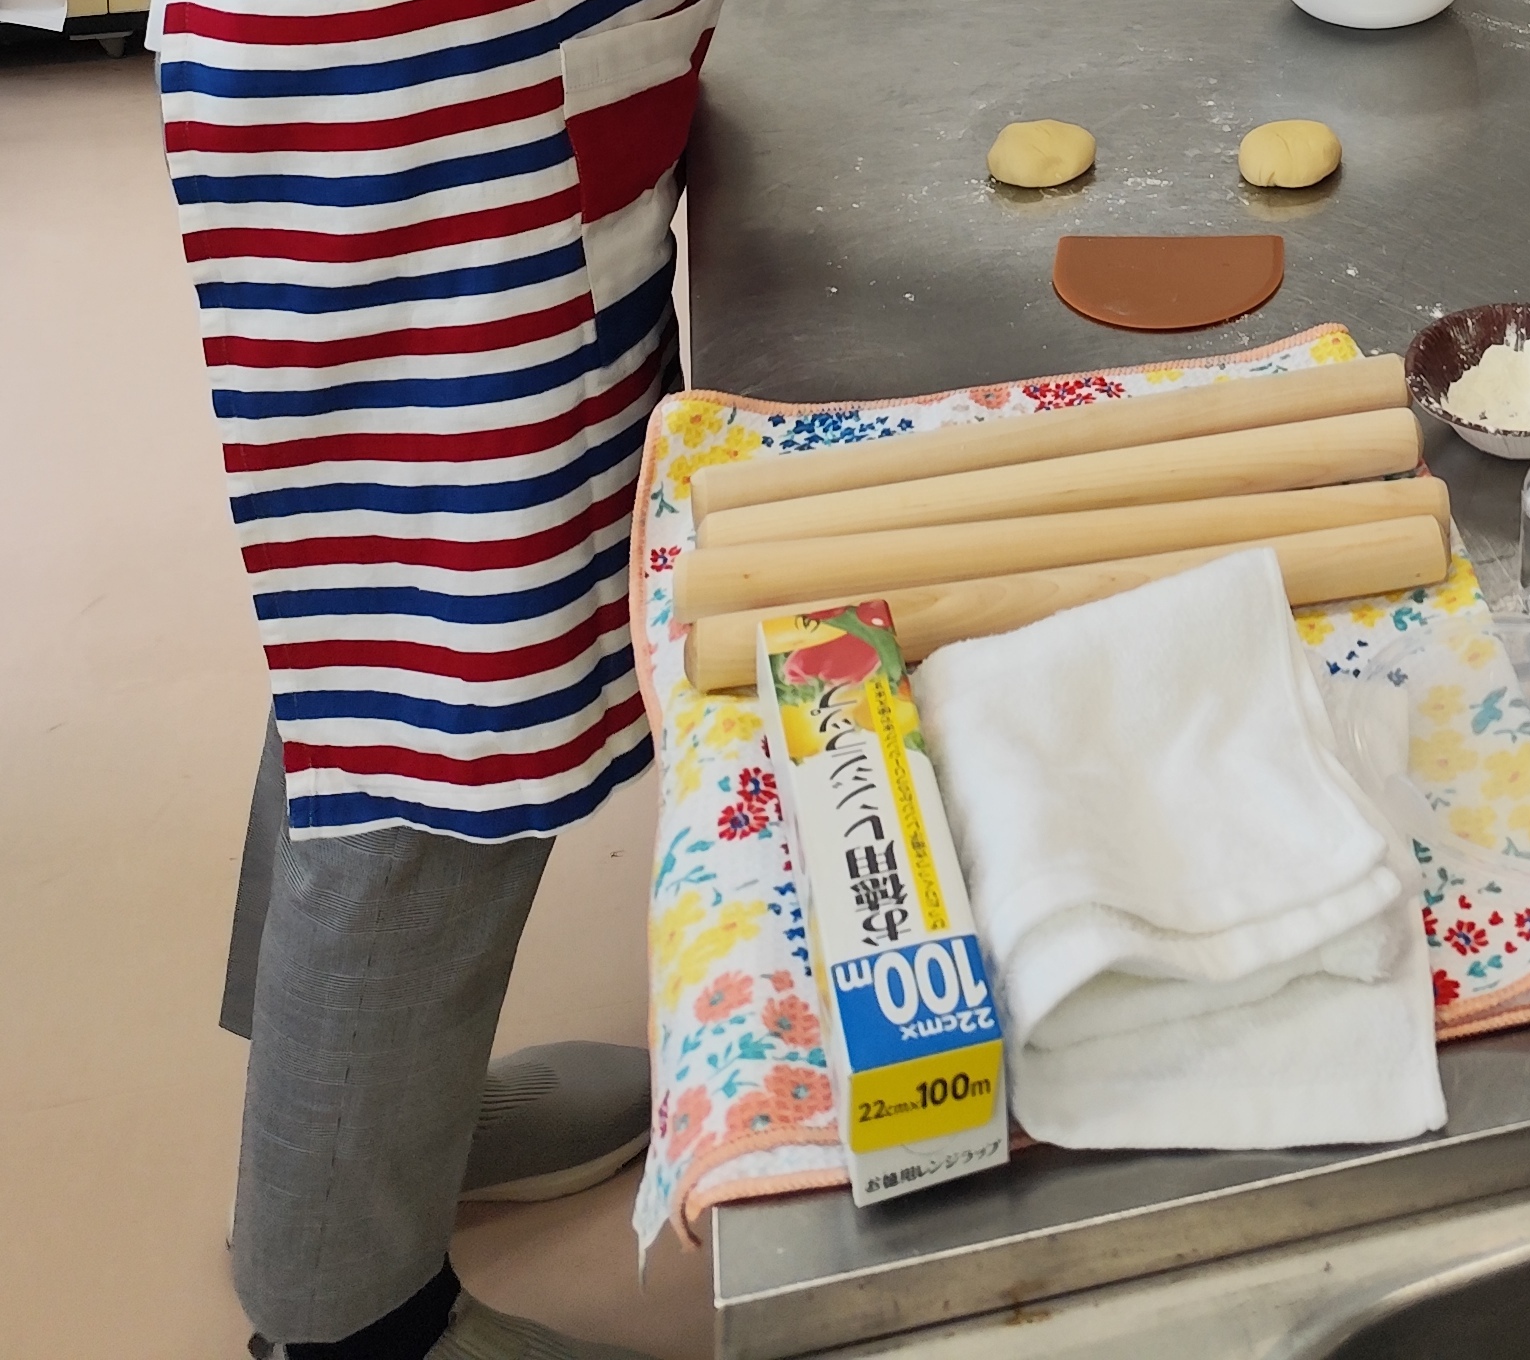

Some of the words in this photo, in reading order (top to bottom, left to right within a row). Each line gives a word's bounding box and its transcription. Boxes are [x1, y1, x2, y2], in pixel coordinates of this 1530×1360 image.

[810, 682, 912, 947] お徳用レンジラップ
[834, 938, 989, 1026] 100m
